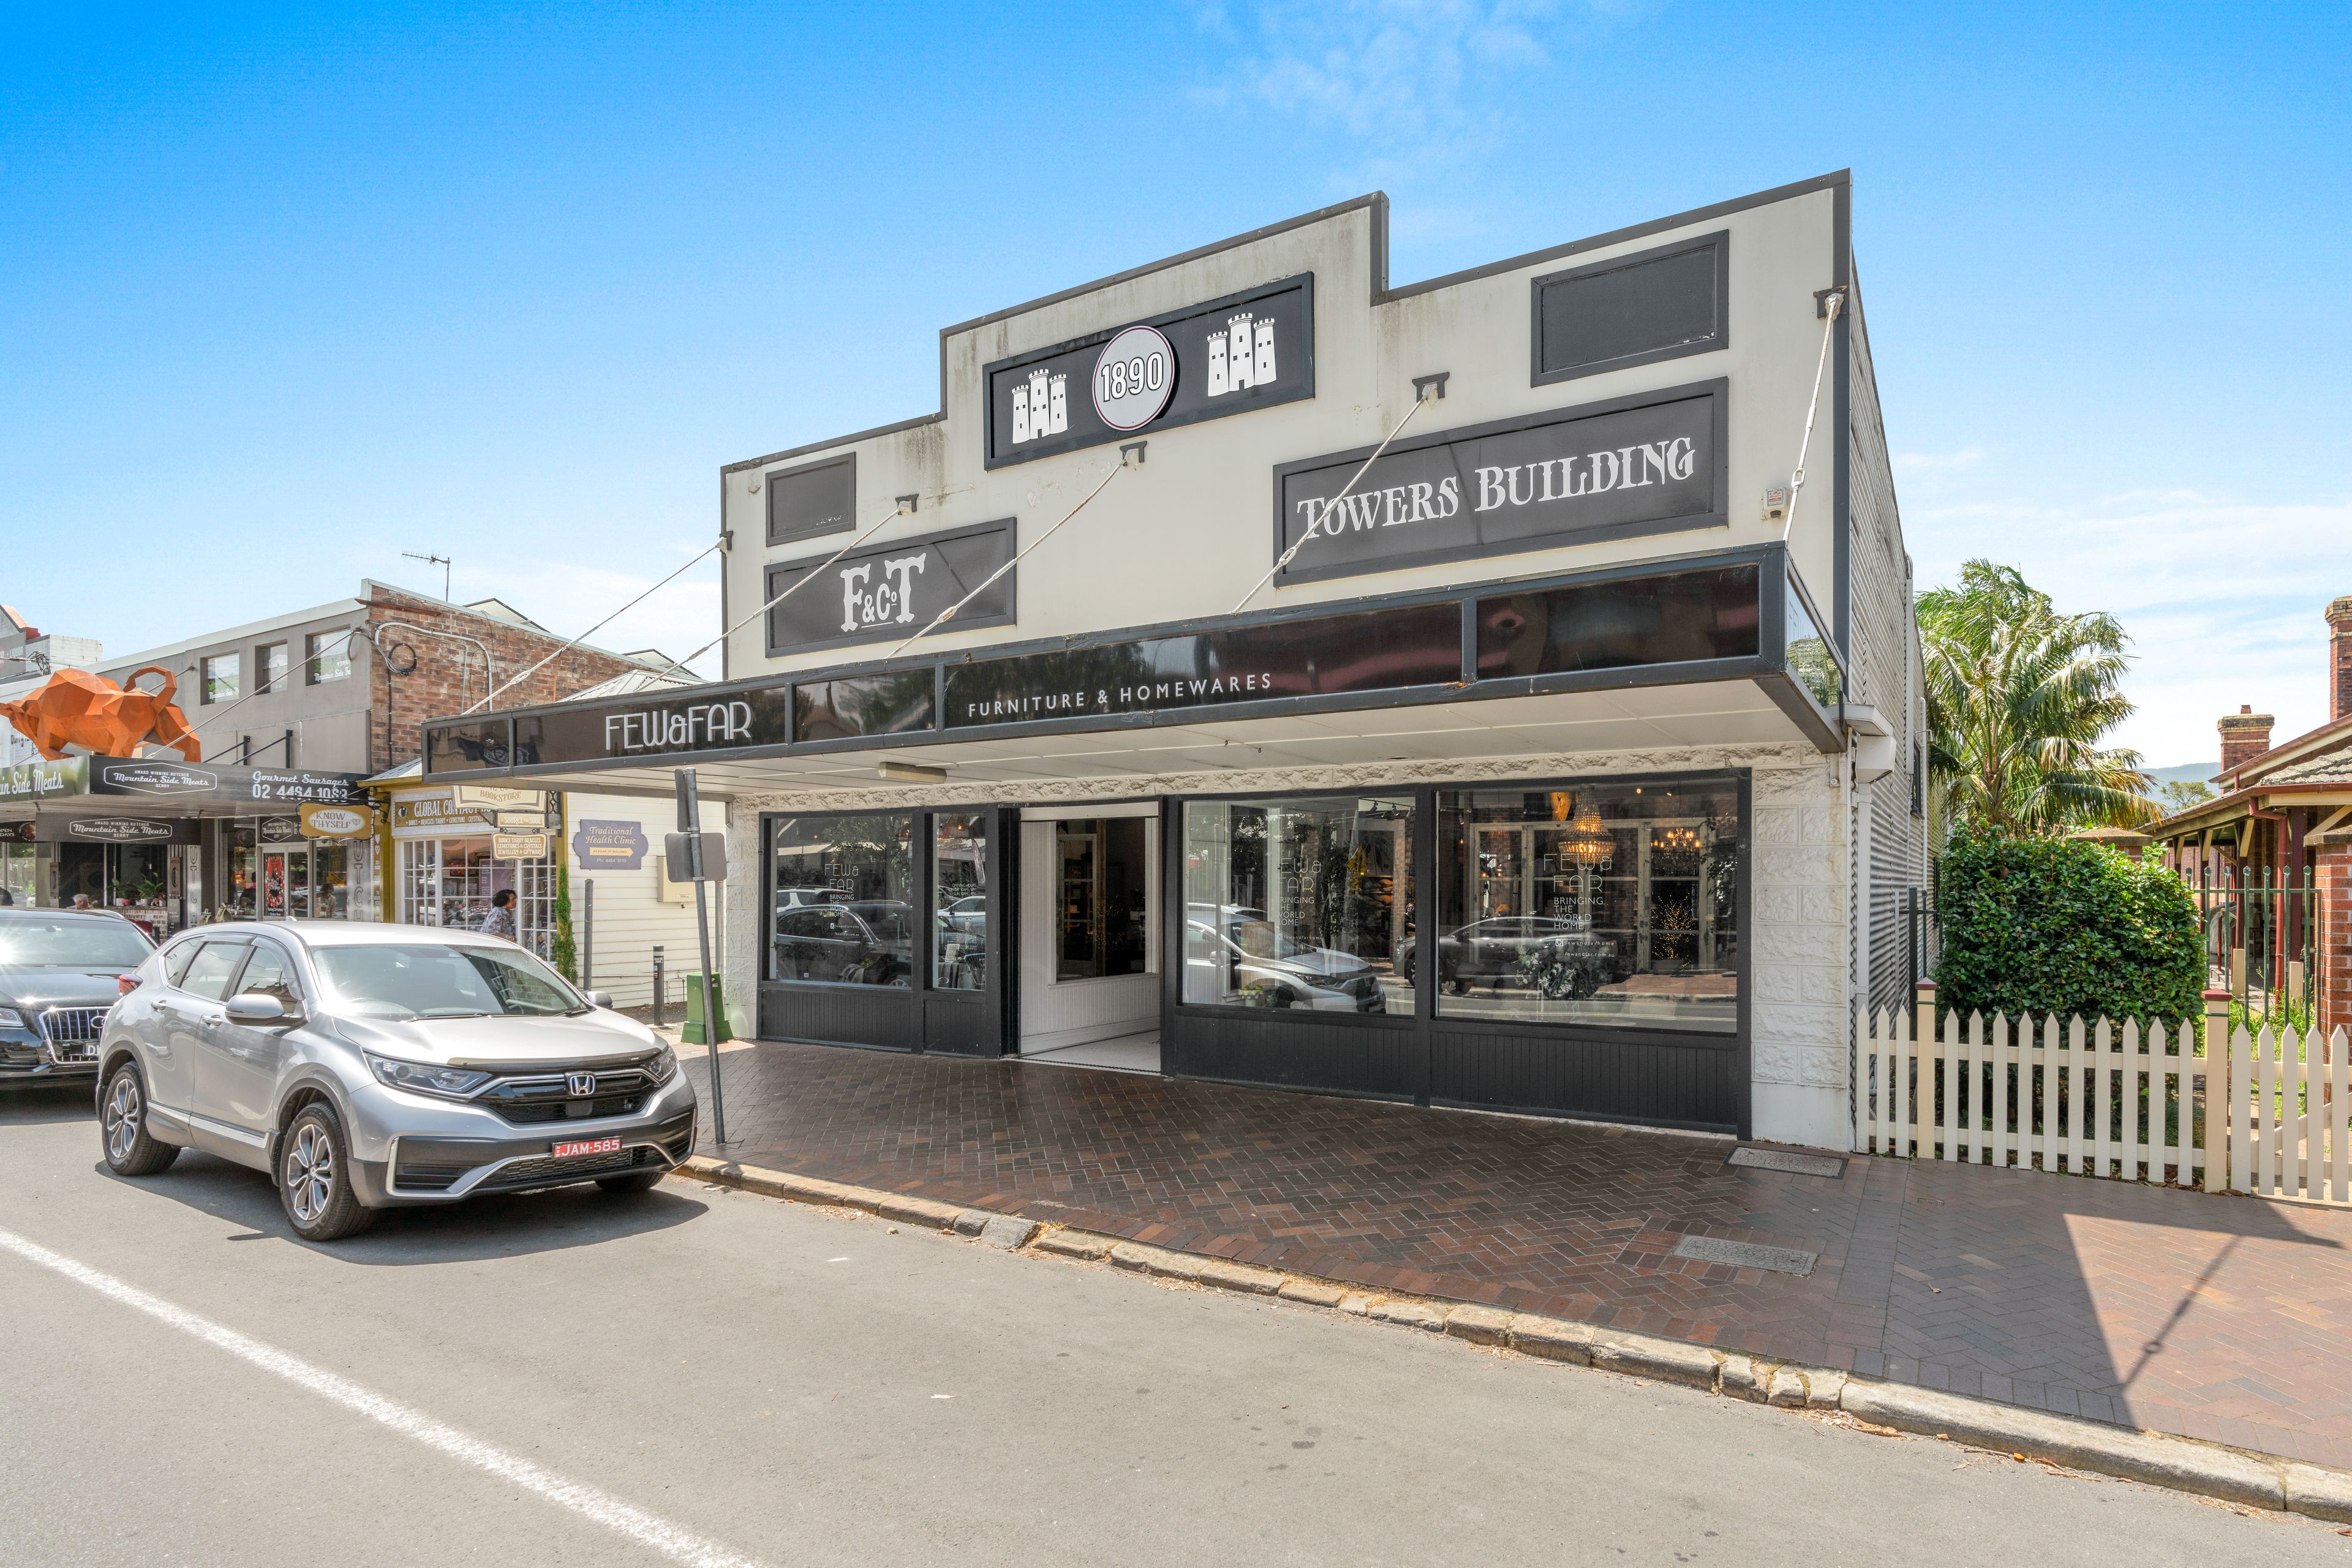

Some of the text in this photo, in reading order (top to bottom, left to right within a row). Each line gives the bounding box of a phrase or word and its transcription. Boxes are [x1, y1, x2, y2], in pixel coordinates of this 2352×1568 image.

[1101, 352, 1164, 403] 1890
[1297, 437, 1696, 540] TOWERS BUILDING
[968, 673, 1271, 718] FURNITURE & HOMEWARES
[12, 771, 32, 794] Side
[33, 769, 64, 795] Meats
[113, 772, 159, 783] Mountain
[182, 777, 209, 786] Meats
[252, 771, 349, 788] Gourmet Sausages
[252, 783, 271, 799] 02
[480, 790, 521, 802] BOOKSTORE
[414, 800, 442, 817] GLOBAL
[311, 820, 351, 829] THYSELF
[504, 816, 524, 825] SOURCE
[73, 824, 118, 833] Mountain
[141, 826, 169, 835] Meats
[589, 826, 634, 835] Traditional
[585, 835, 636, 844] Health Clinic
[1281, 858, 1322, 873] EW&
[1544, 853, 1613, 871] FEW&
[824, 864, 859, 876] FEW&
[829, 879, 854, 892] FAR
[1553, 875, 1602, 892] FAR
